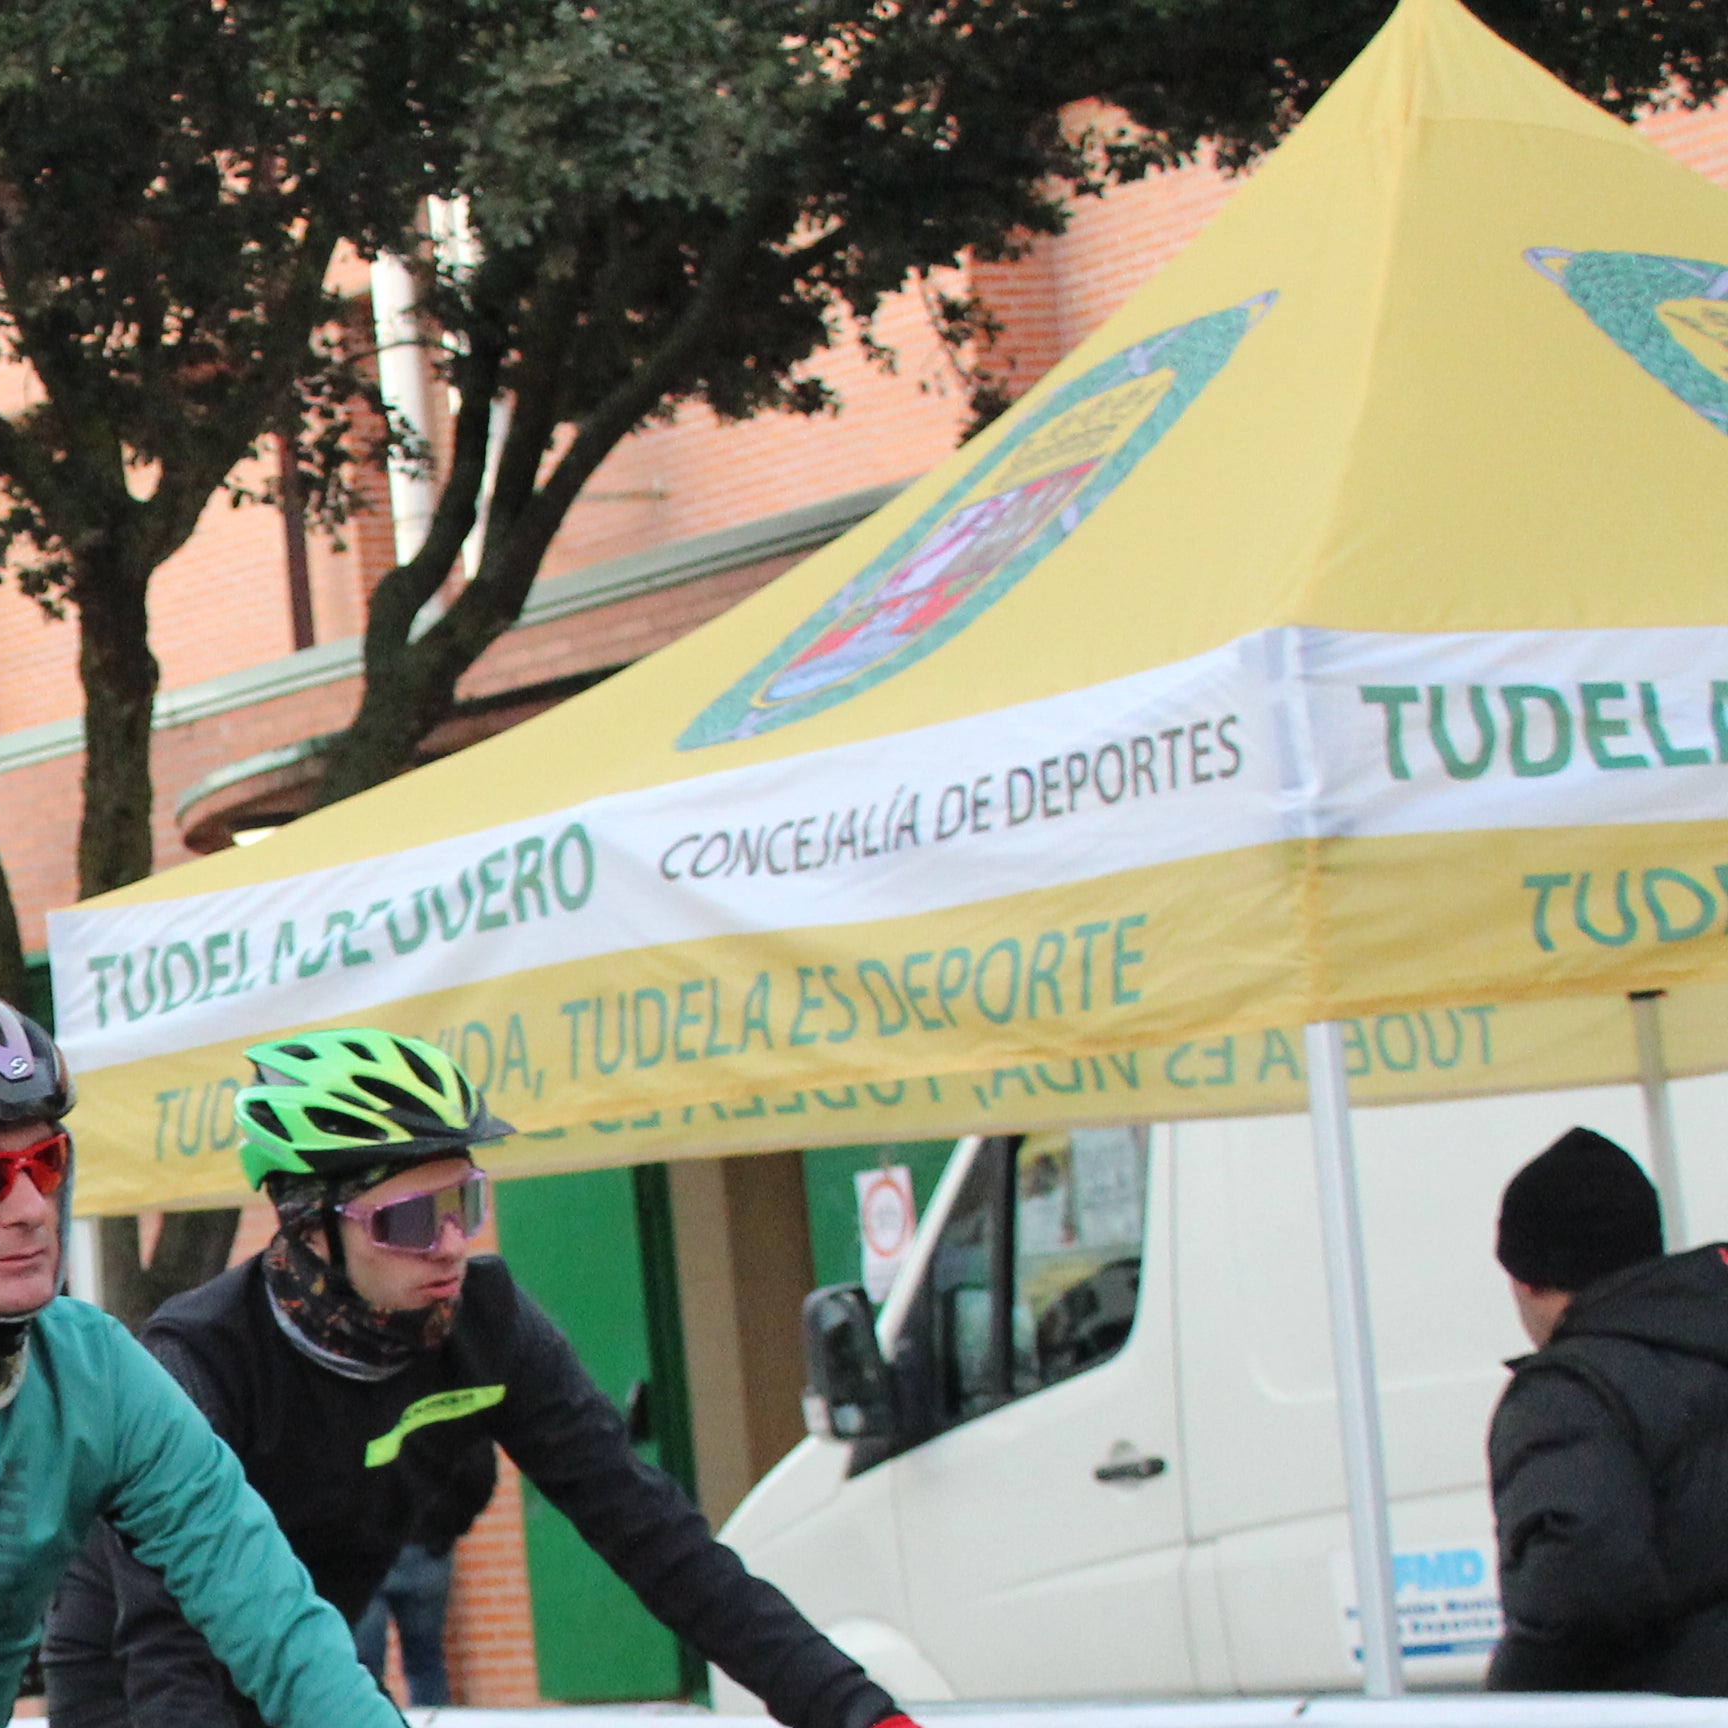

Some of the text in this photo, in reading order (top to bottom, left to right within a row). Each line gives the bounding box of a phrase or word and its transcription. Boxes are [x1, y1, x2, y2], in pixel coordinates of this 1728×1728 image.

[661, 714, 1244, 881] CONCEJALÍA DE DEPORTES
[1522, 866, 1728, 951] TUD
[155, 1077, 241, 1161] TUD
[559, 970, 773, 1080] TUDELA
[788, 964, 861, 1048] ES
[858, 912, 1148, 1038] DEPORTE
